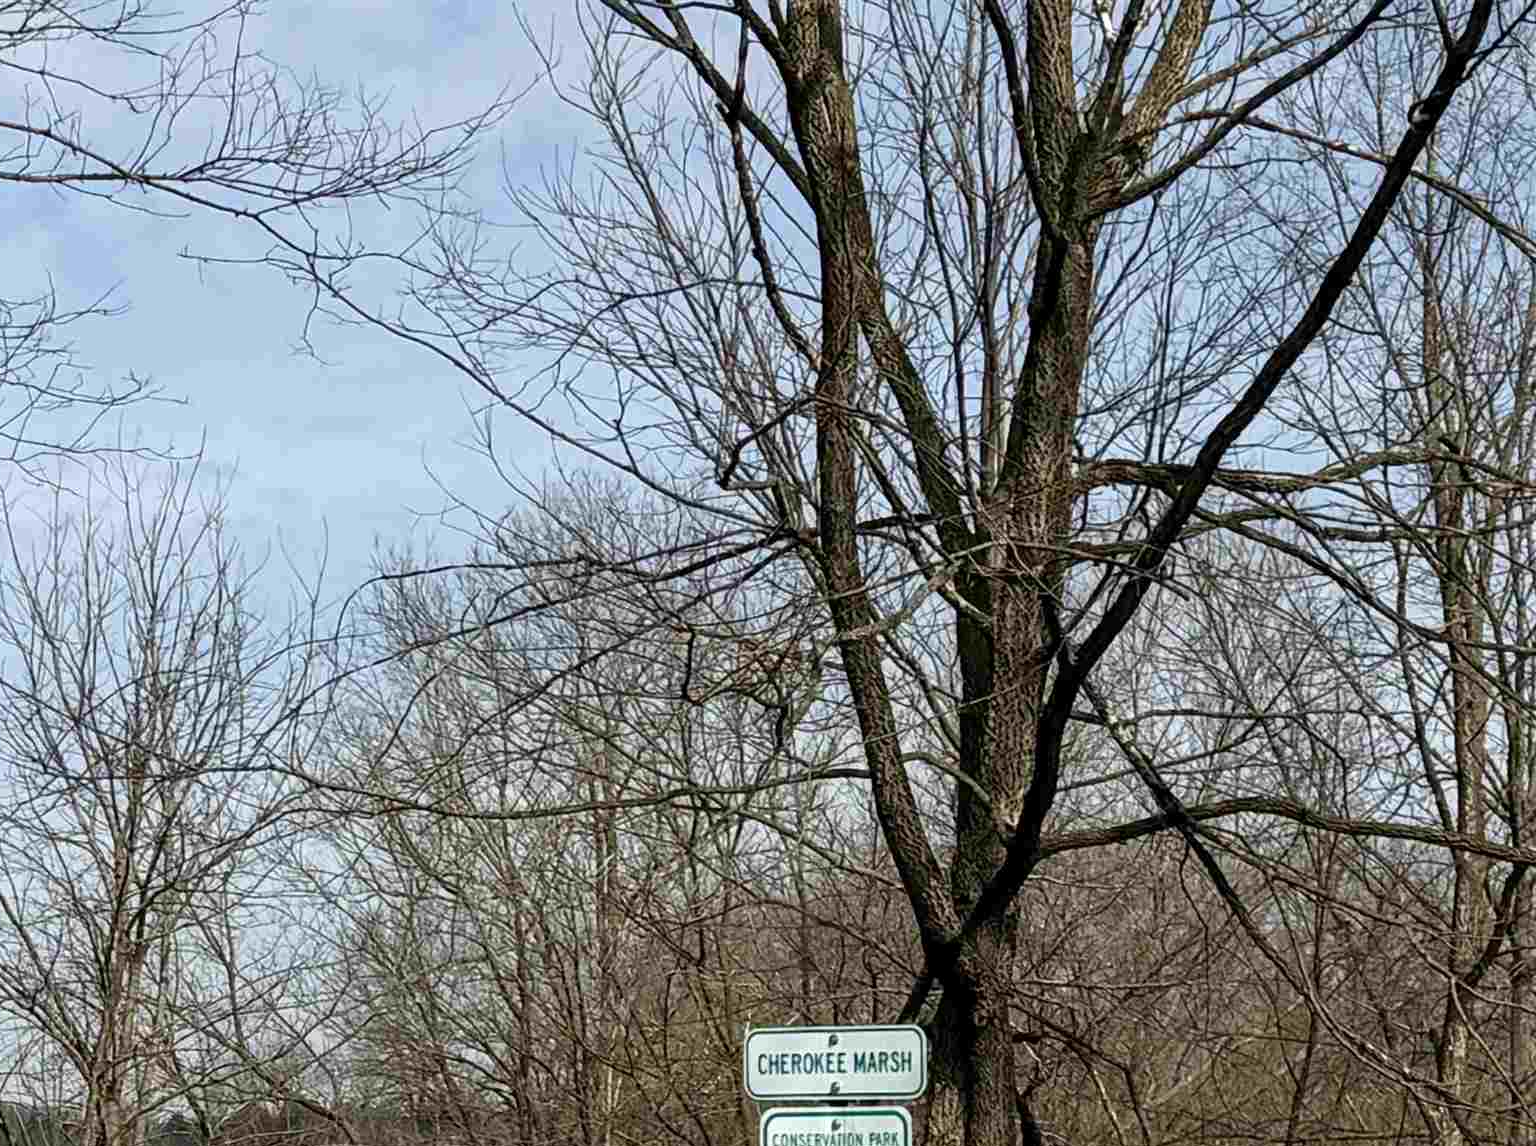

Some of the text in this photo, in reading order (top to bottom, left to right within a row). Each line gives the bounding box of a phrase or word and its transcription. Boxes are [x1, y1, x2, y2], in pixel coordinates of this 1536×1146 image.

[758, 1051, 912, 1075] CHEROKEE MARSH
[869, 1132, 900, 1146] PARK
